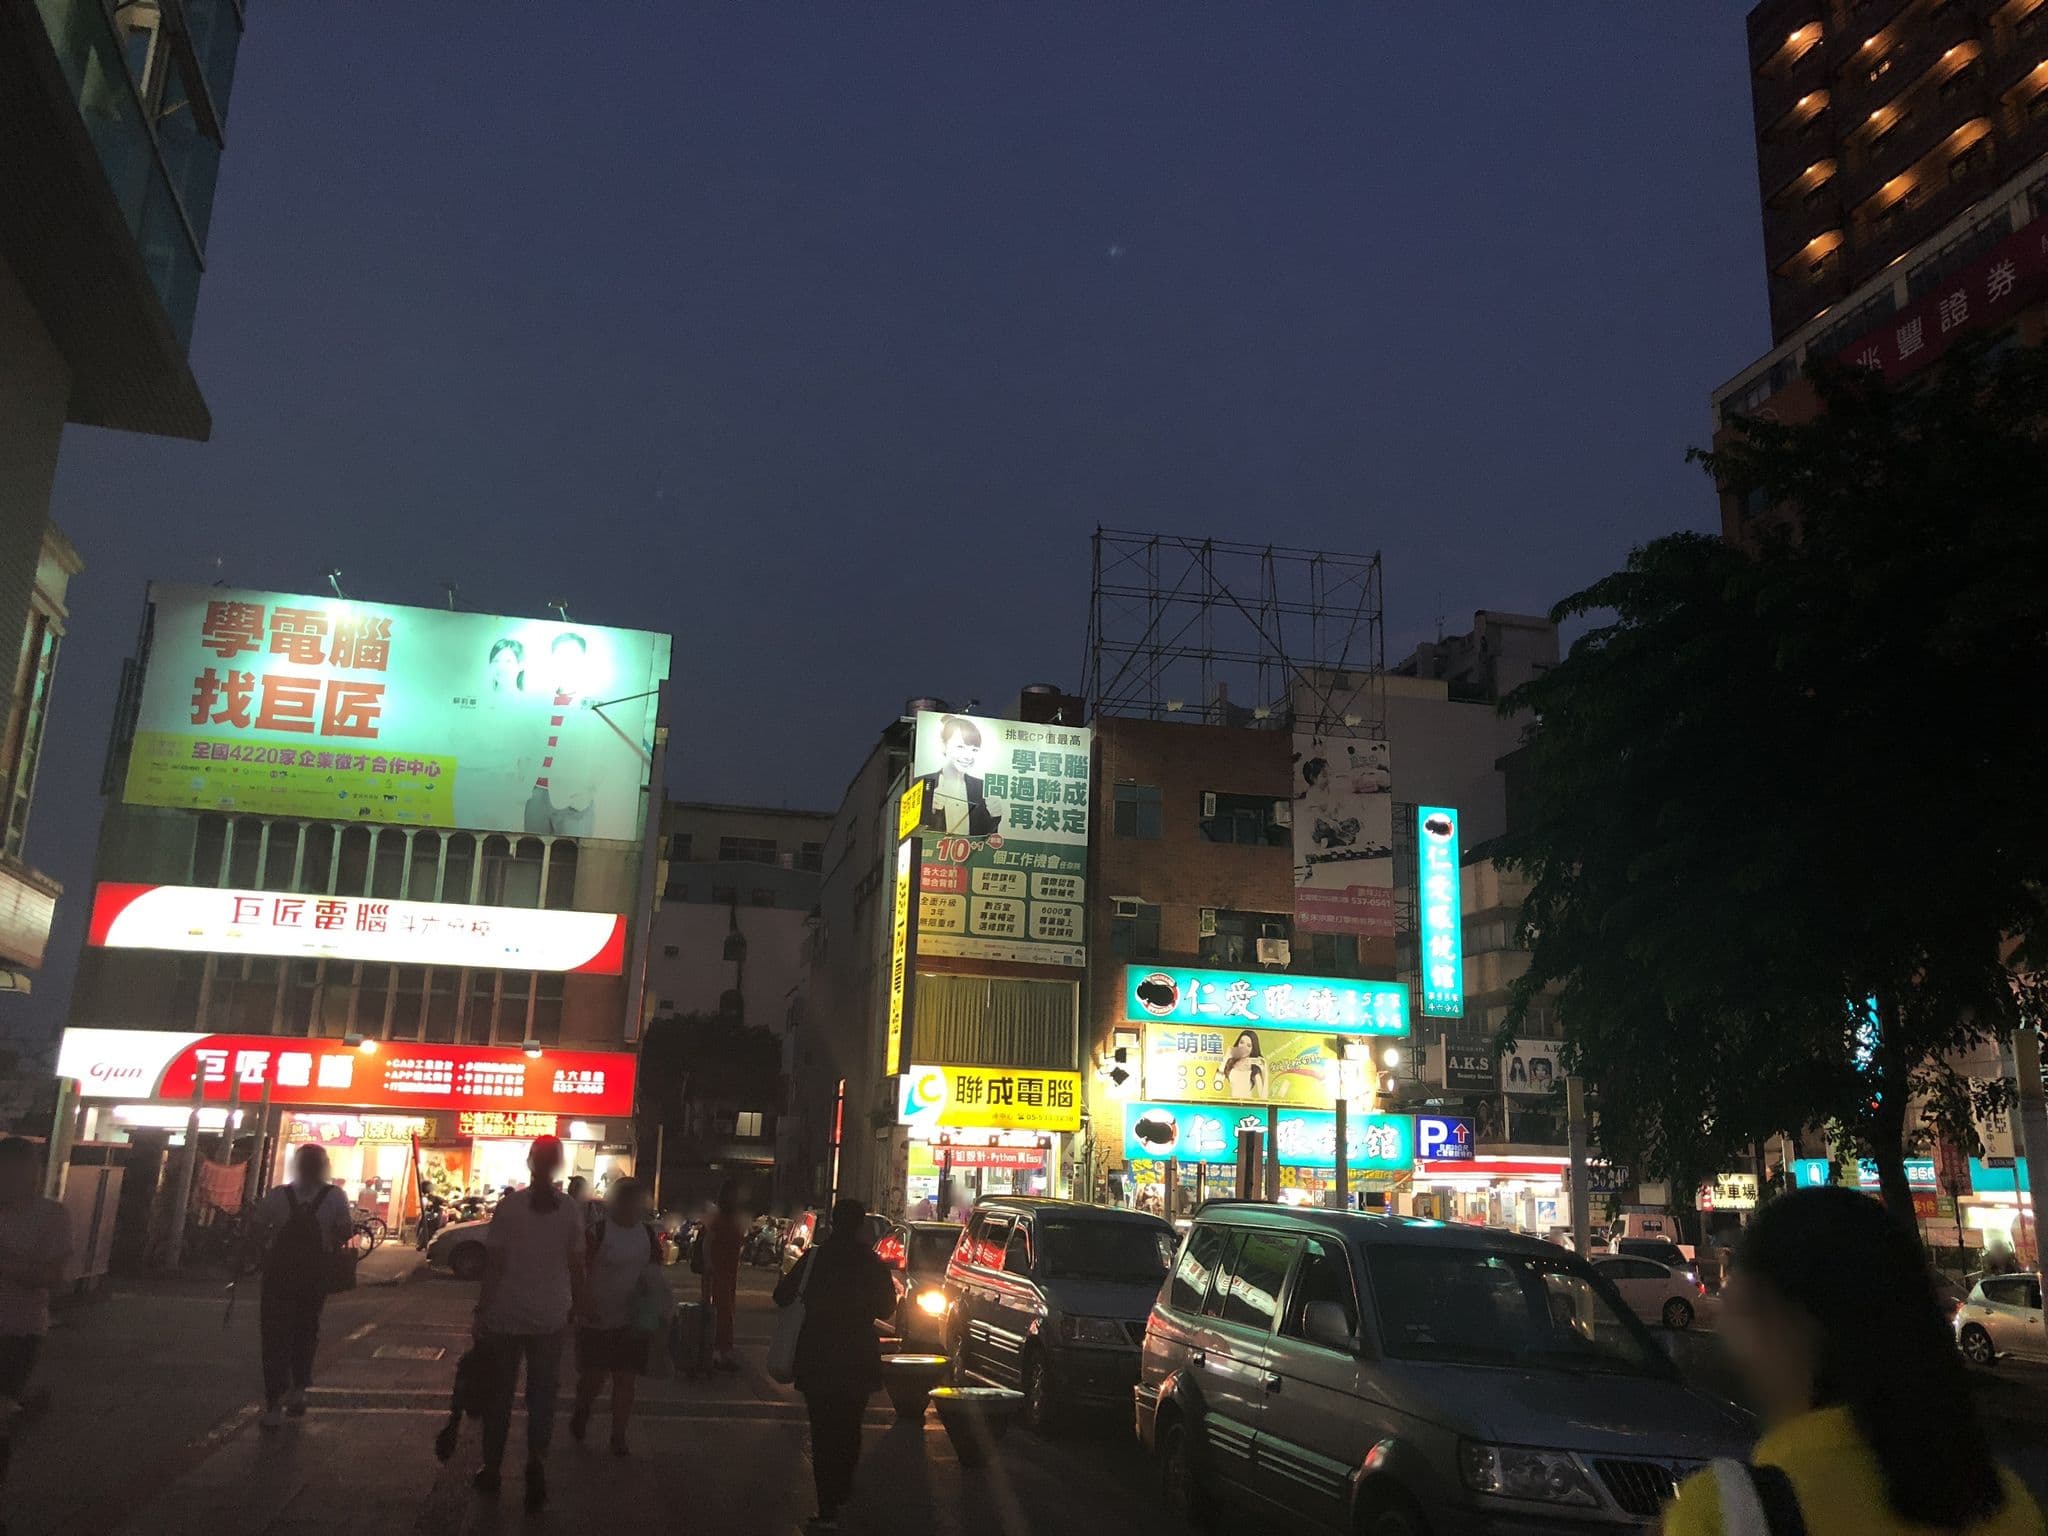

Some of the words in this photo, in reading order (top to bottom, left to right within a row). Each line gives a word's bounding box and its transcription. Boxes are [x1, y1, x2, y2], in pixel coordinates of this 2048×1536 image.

[201, 600, 393, 672] 學電腦
[190, 668, 385, 739] 找巨匠
[1005, 729, 1081, 747] 挑戰CP值最高
[1011, 749, 1089, 780] 學電腦
[983, 773, 1088, 807] 問過聯成
[1008, 803, 1087, 835] 再決定
[230, 896, 391, 934] 巨匠電腦
[1176, 1032, 1224, 1055] 萌瞳
[956, 1075, 1073, 1108] 聯成電腦
[1420, 1119, 1448, 1157] P
[991, 1152, 1017, 1163] Python
[1713, 1182, 1757, 1201] 停車場
